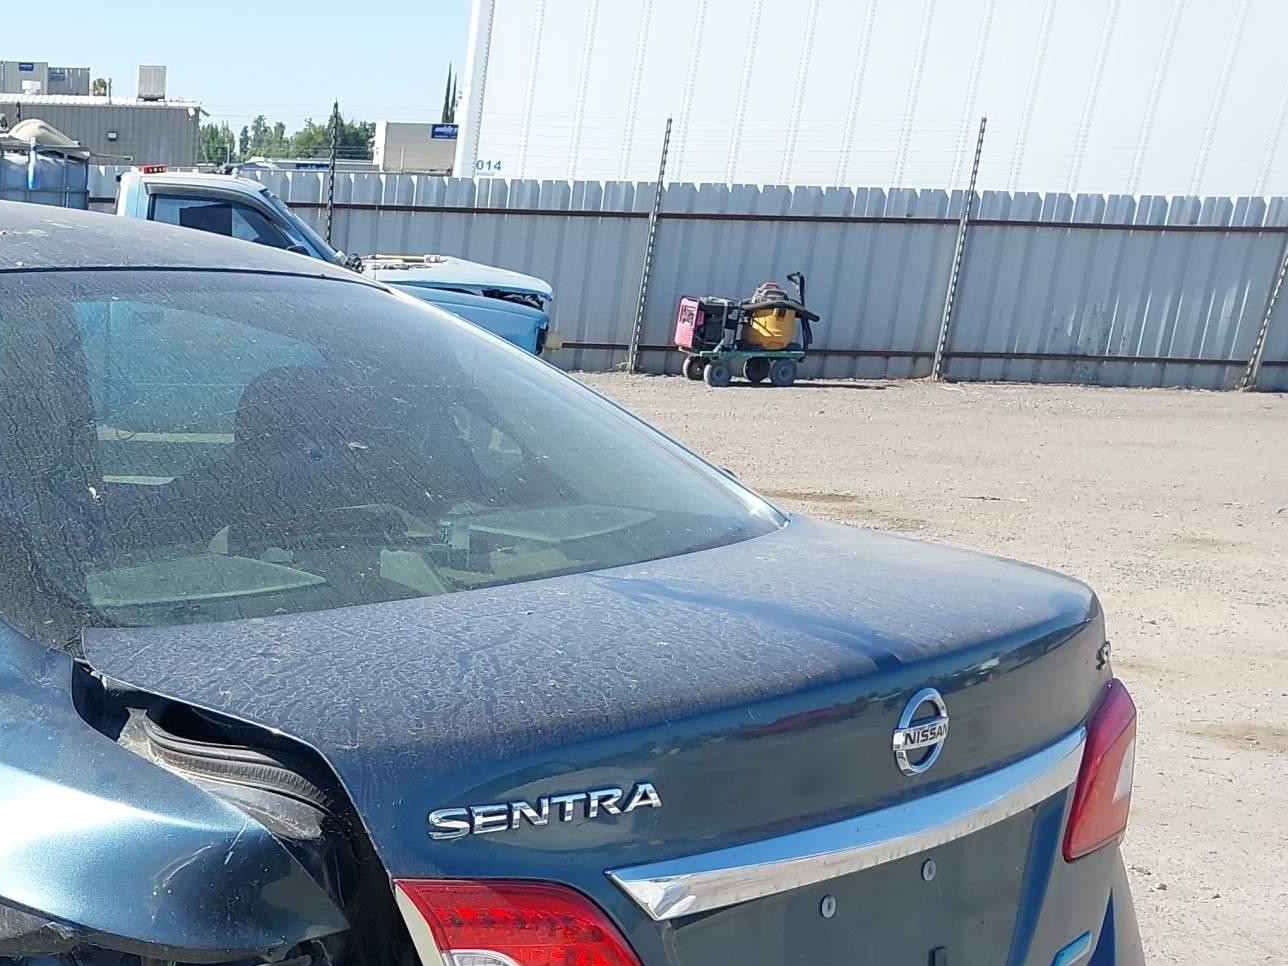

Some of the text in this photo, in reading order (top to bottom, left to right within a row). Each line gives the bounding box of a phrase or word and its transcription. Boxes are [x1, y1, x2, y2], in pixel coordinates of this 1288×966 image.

[476, 160, 502, 171] 014
[904, 723, 948, 746] NISSAN
[428, 782, 663, 840] SENTRA
